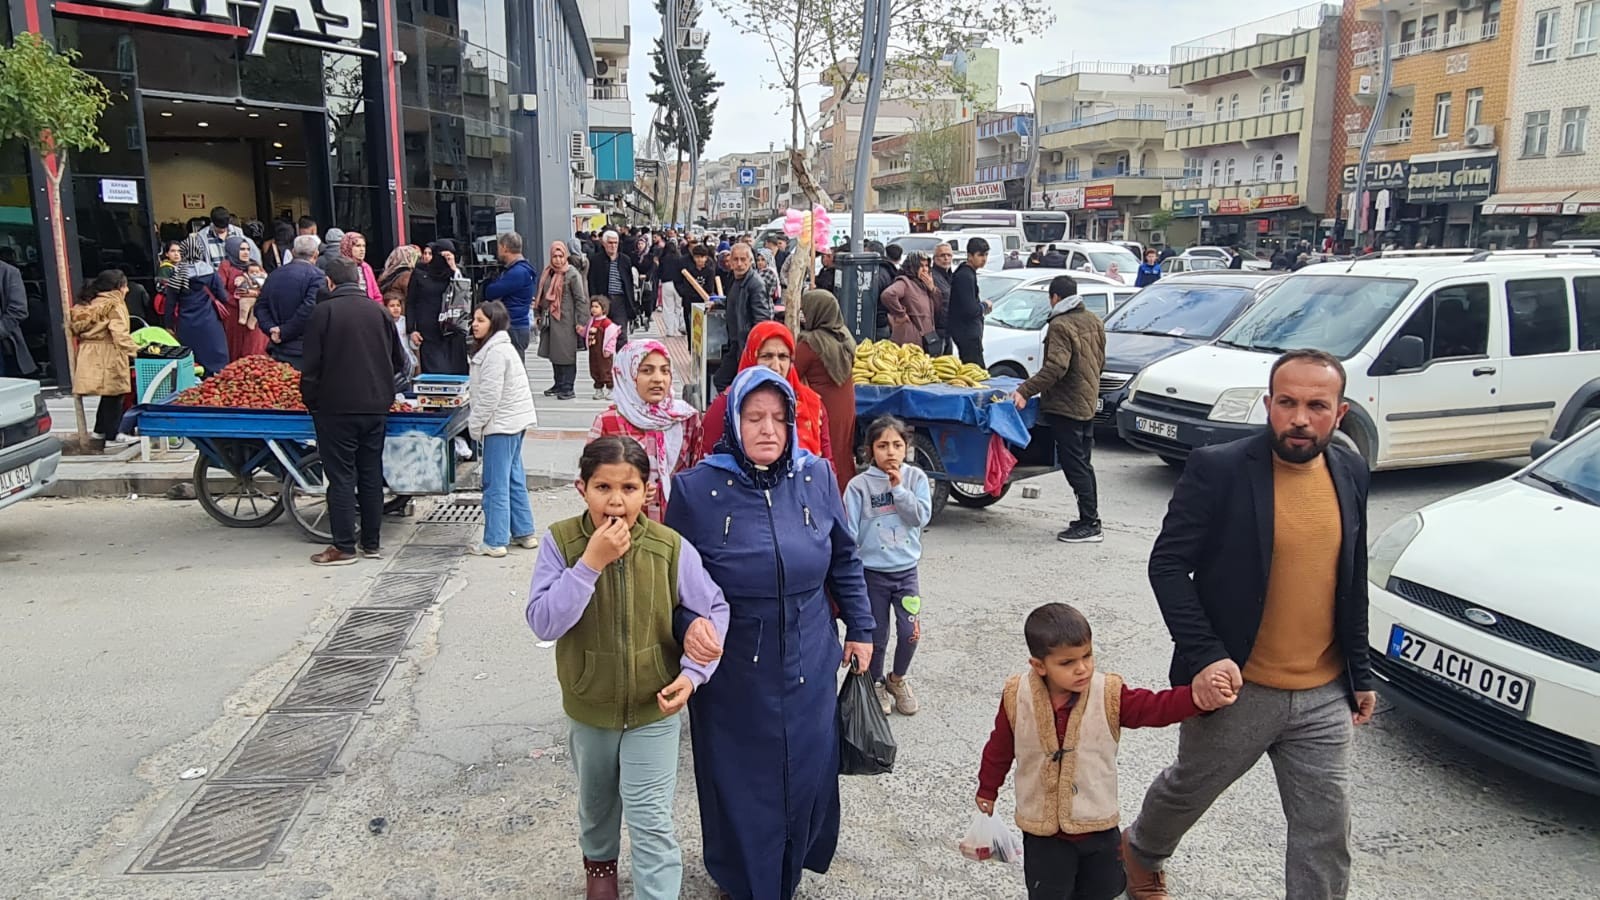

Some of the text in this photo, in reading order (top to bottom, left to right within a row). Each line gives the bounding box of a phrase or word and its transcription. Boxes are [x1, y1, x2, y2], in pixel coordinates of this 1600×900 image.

[1149, 420, 1166, 435] HHF
[1400, 635, 1427, 662] 27
[1433, 649, 1474, 685] ACH
[1479, 668, 1525, 706] 019
